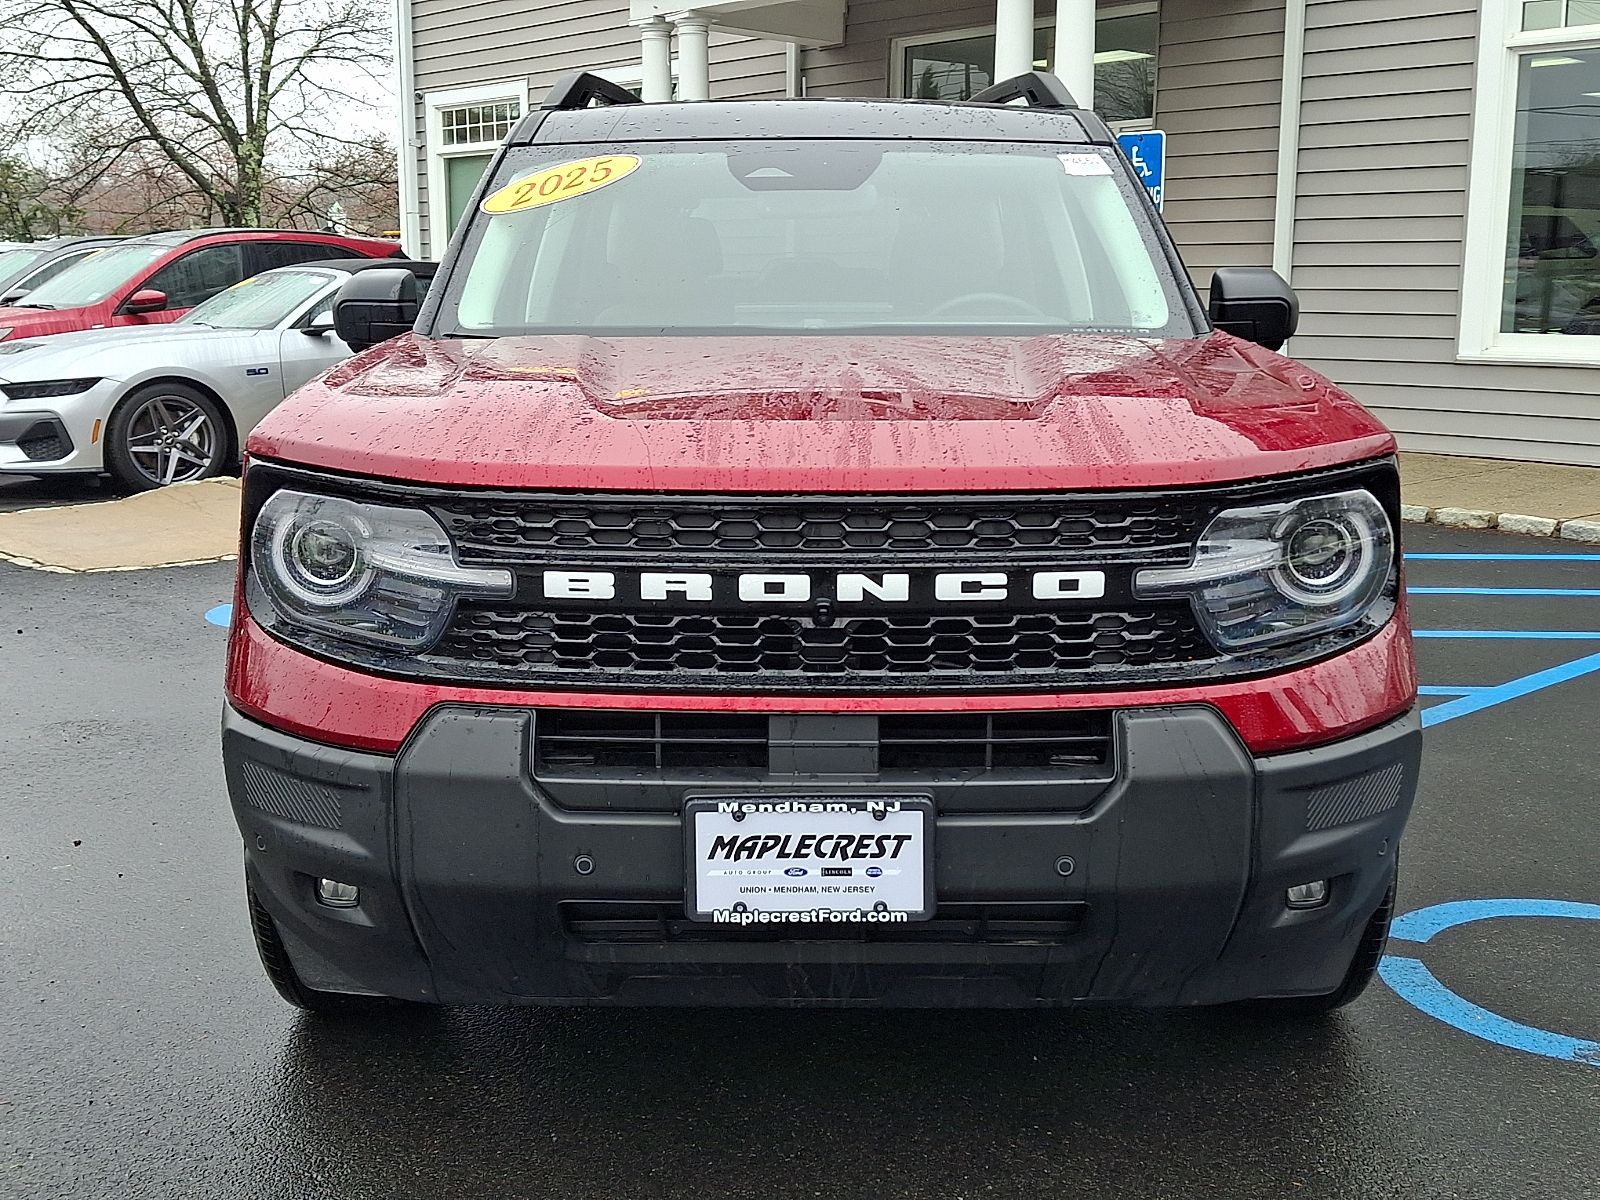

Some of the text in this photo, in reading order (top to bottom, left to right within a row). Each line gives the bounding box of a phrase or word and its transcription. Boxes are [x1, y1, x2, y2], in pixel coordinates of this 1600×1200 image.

[510, 159, 613, 208] 2025
[543, 570, 1106, 602] BRONCO
[717, 801, 901, 814] Mendham, NJ
[707, 834, 912, 862] MAPLECREST
[786, 868, 805, 876] Ford
[739, 886, 876, 895] UNION MENDHAM, NEW JERSEY
[713, 908, 908, 926] MaplecrestFord.com
